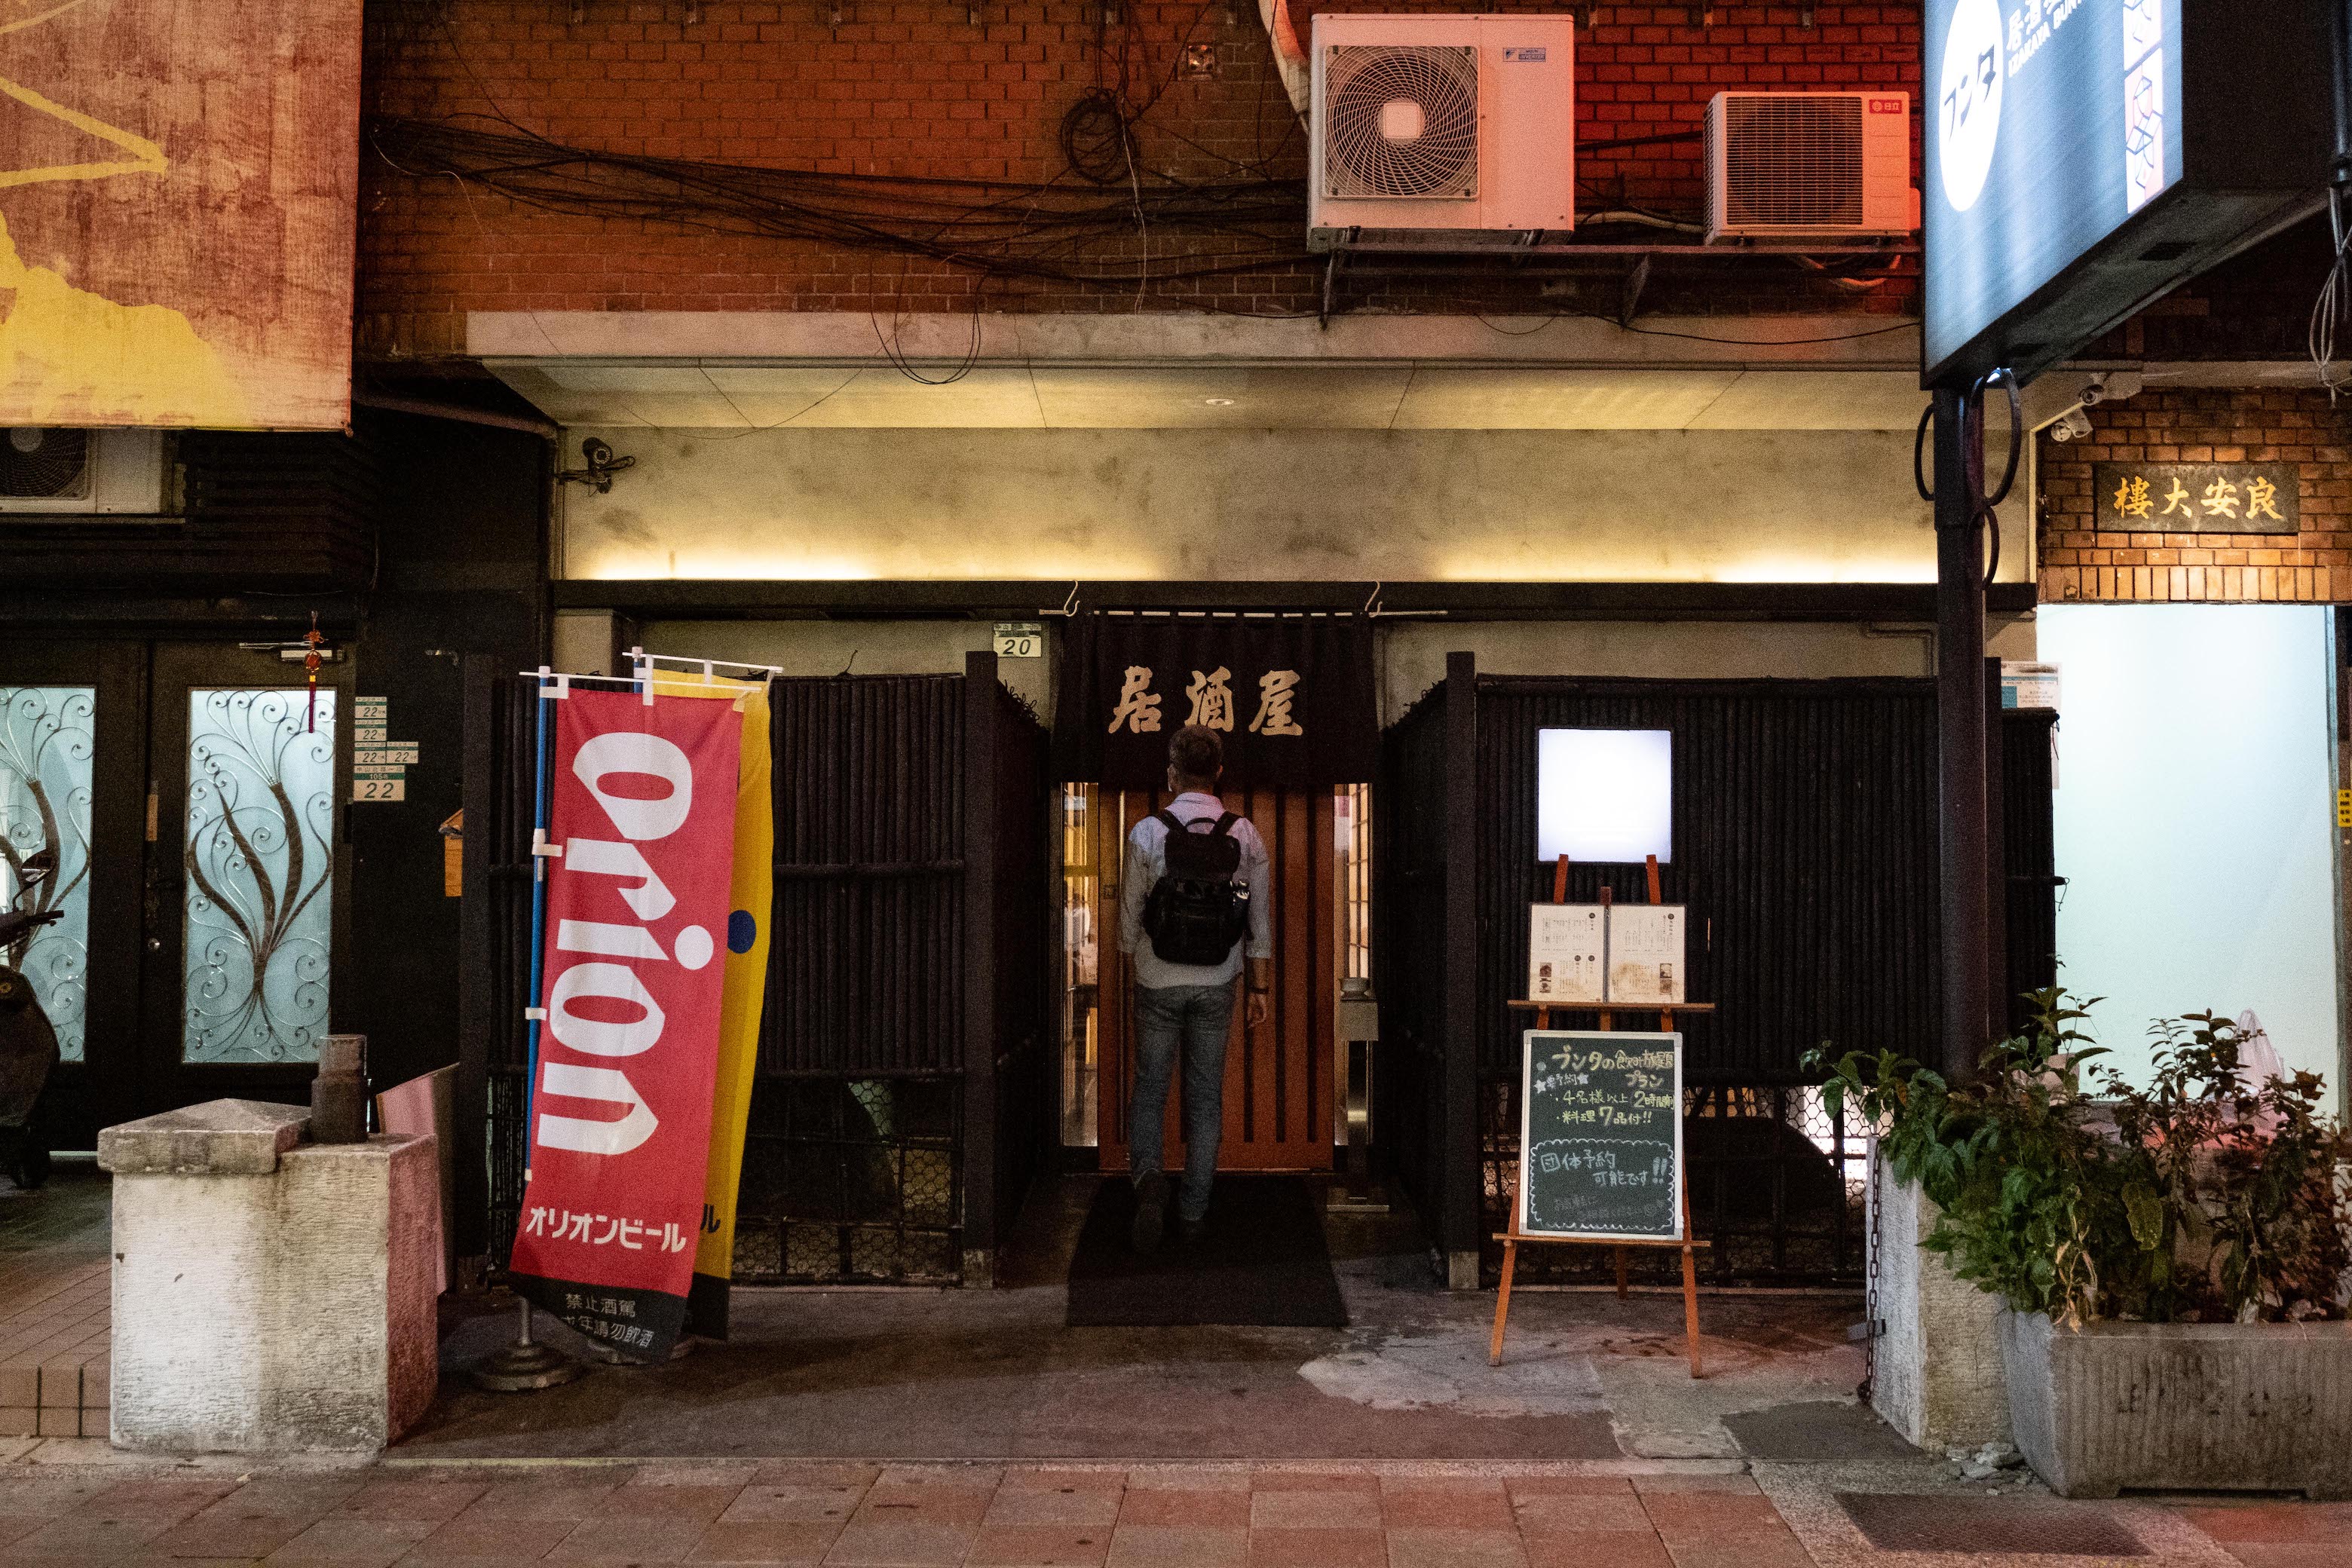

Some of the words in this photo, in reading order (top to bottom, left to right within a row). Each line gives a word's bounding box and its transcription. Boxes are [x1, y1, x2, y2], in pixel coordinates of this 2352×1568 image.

[2008, 21, 2050, 78] IZAKAYA
[1002, 639, 1031, 655] 20
[1107, 665, 1304, 736] 居酒屋
[363, 706, 378, 718] 22
[363, 729, 378, 740] 22
[362, 752, 378, 763] 22
[394, 752, 410, 762] 22
[363, 782, 394, 799] 22
[1625, 1070, 1664, 1088] プラン
[1540, 1149, 1616, 1173] 団体予約
[526, 1206, 687, 1253] オリオンビール
[565, 1293, 636, 1318] 禁止酒駕
